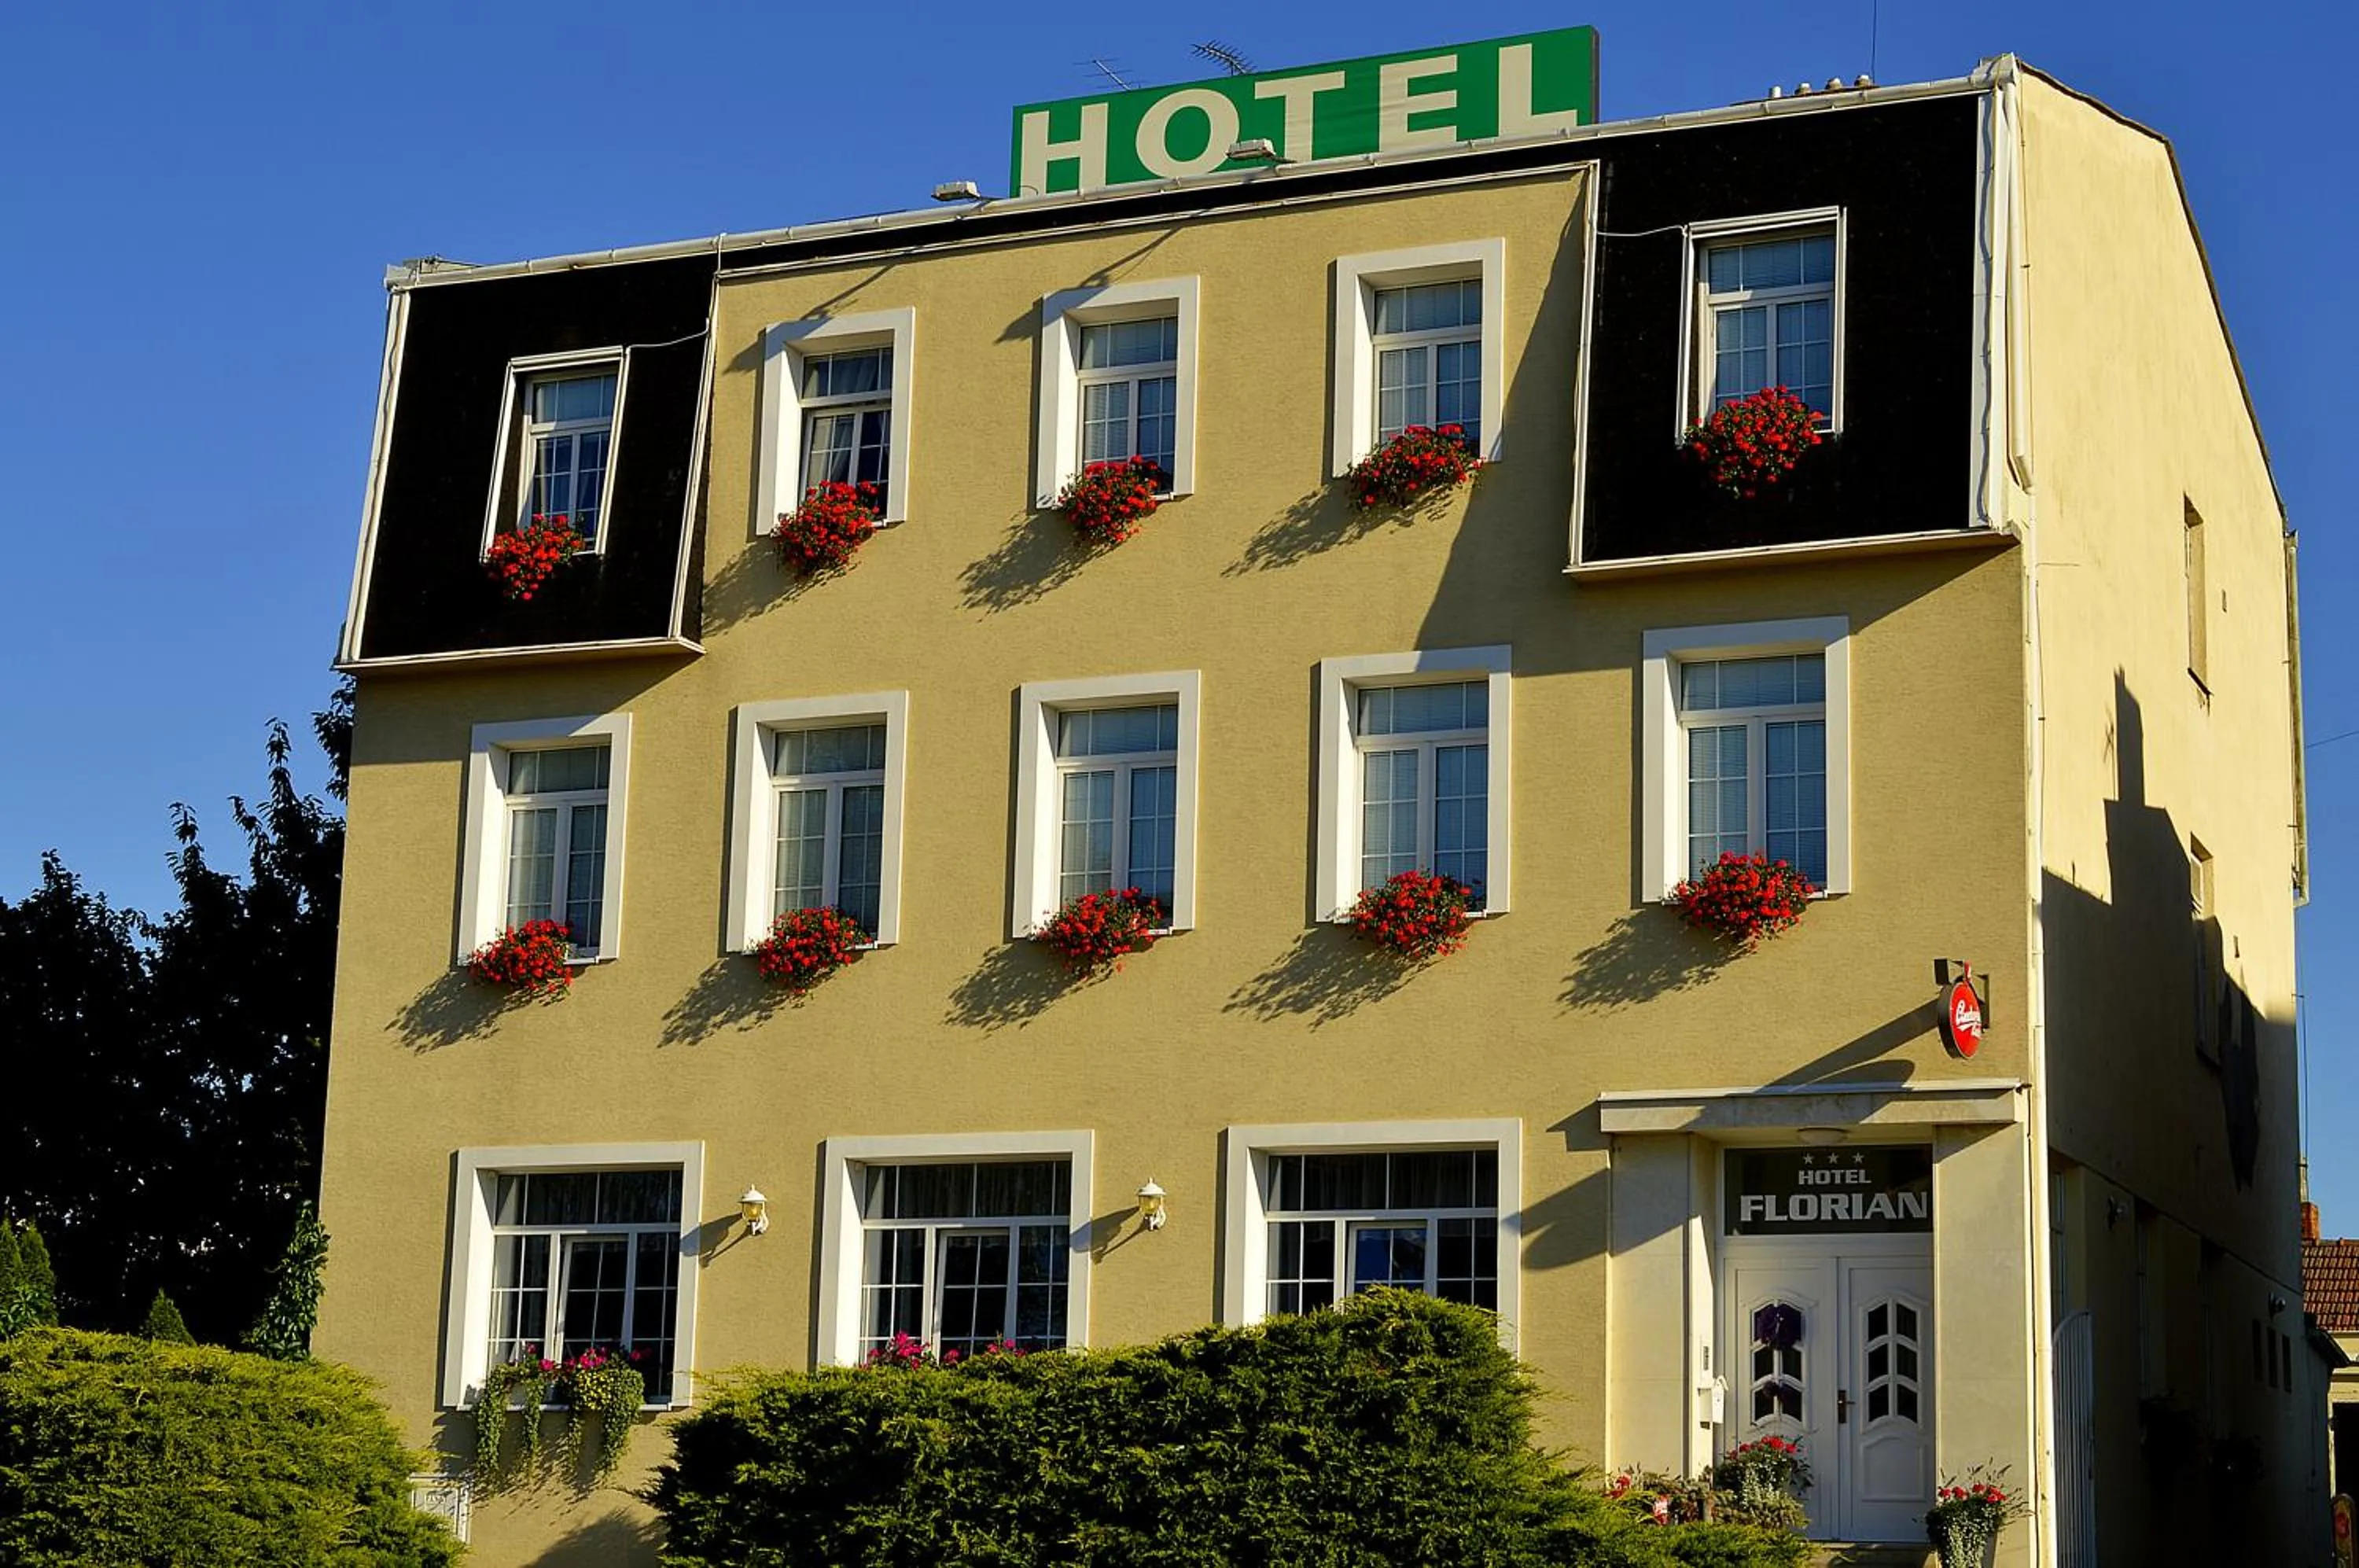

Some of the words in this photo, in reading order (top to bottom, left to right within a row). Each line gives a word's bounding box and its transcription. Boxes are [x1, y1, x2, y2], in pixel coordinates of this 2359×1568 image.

[1020, 42, 1577, 197] HOTEL
[1798, 1169, 1871, 1185] HOTEL
[1740, 1192, 1927, 1221] FLORIAN
